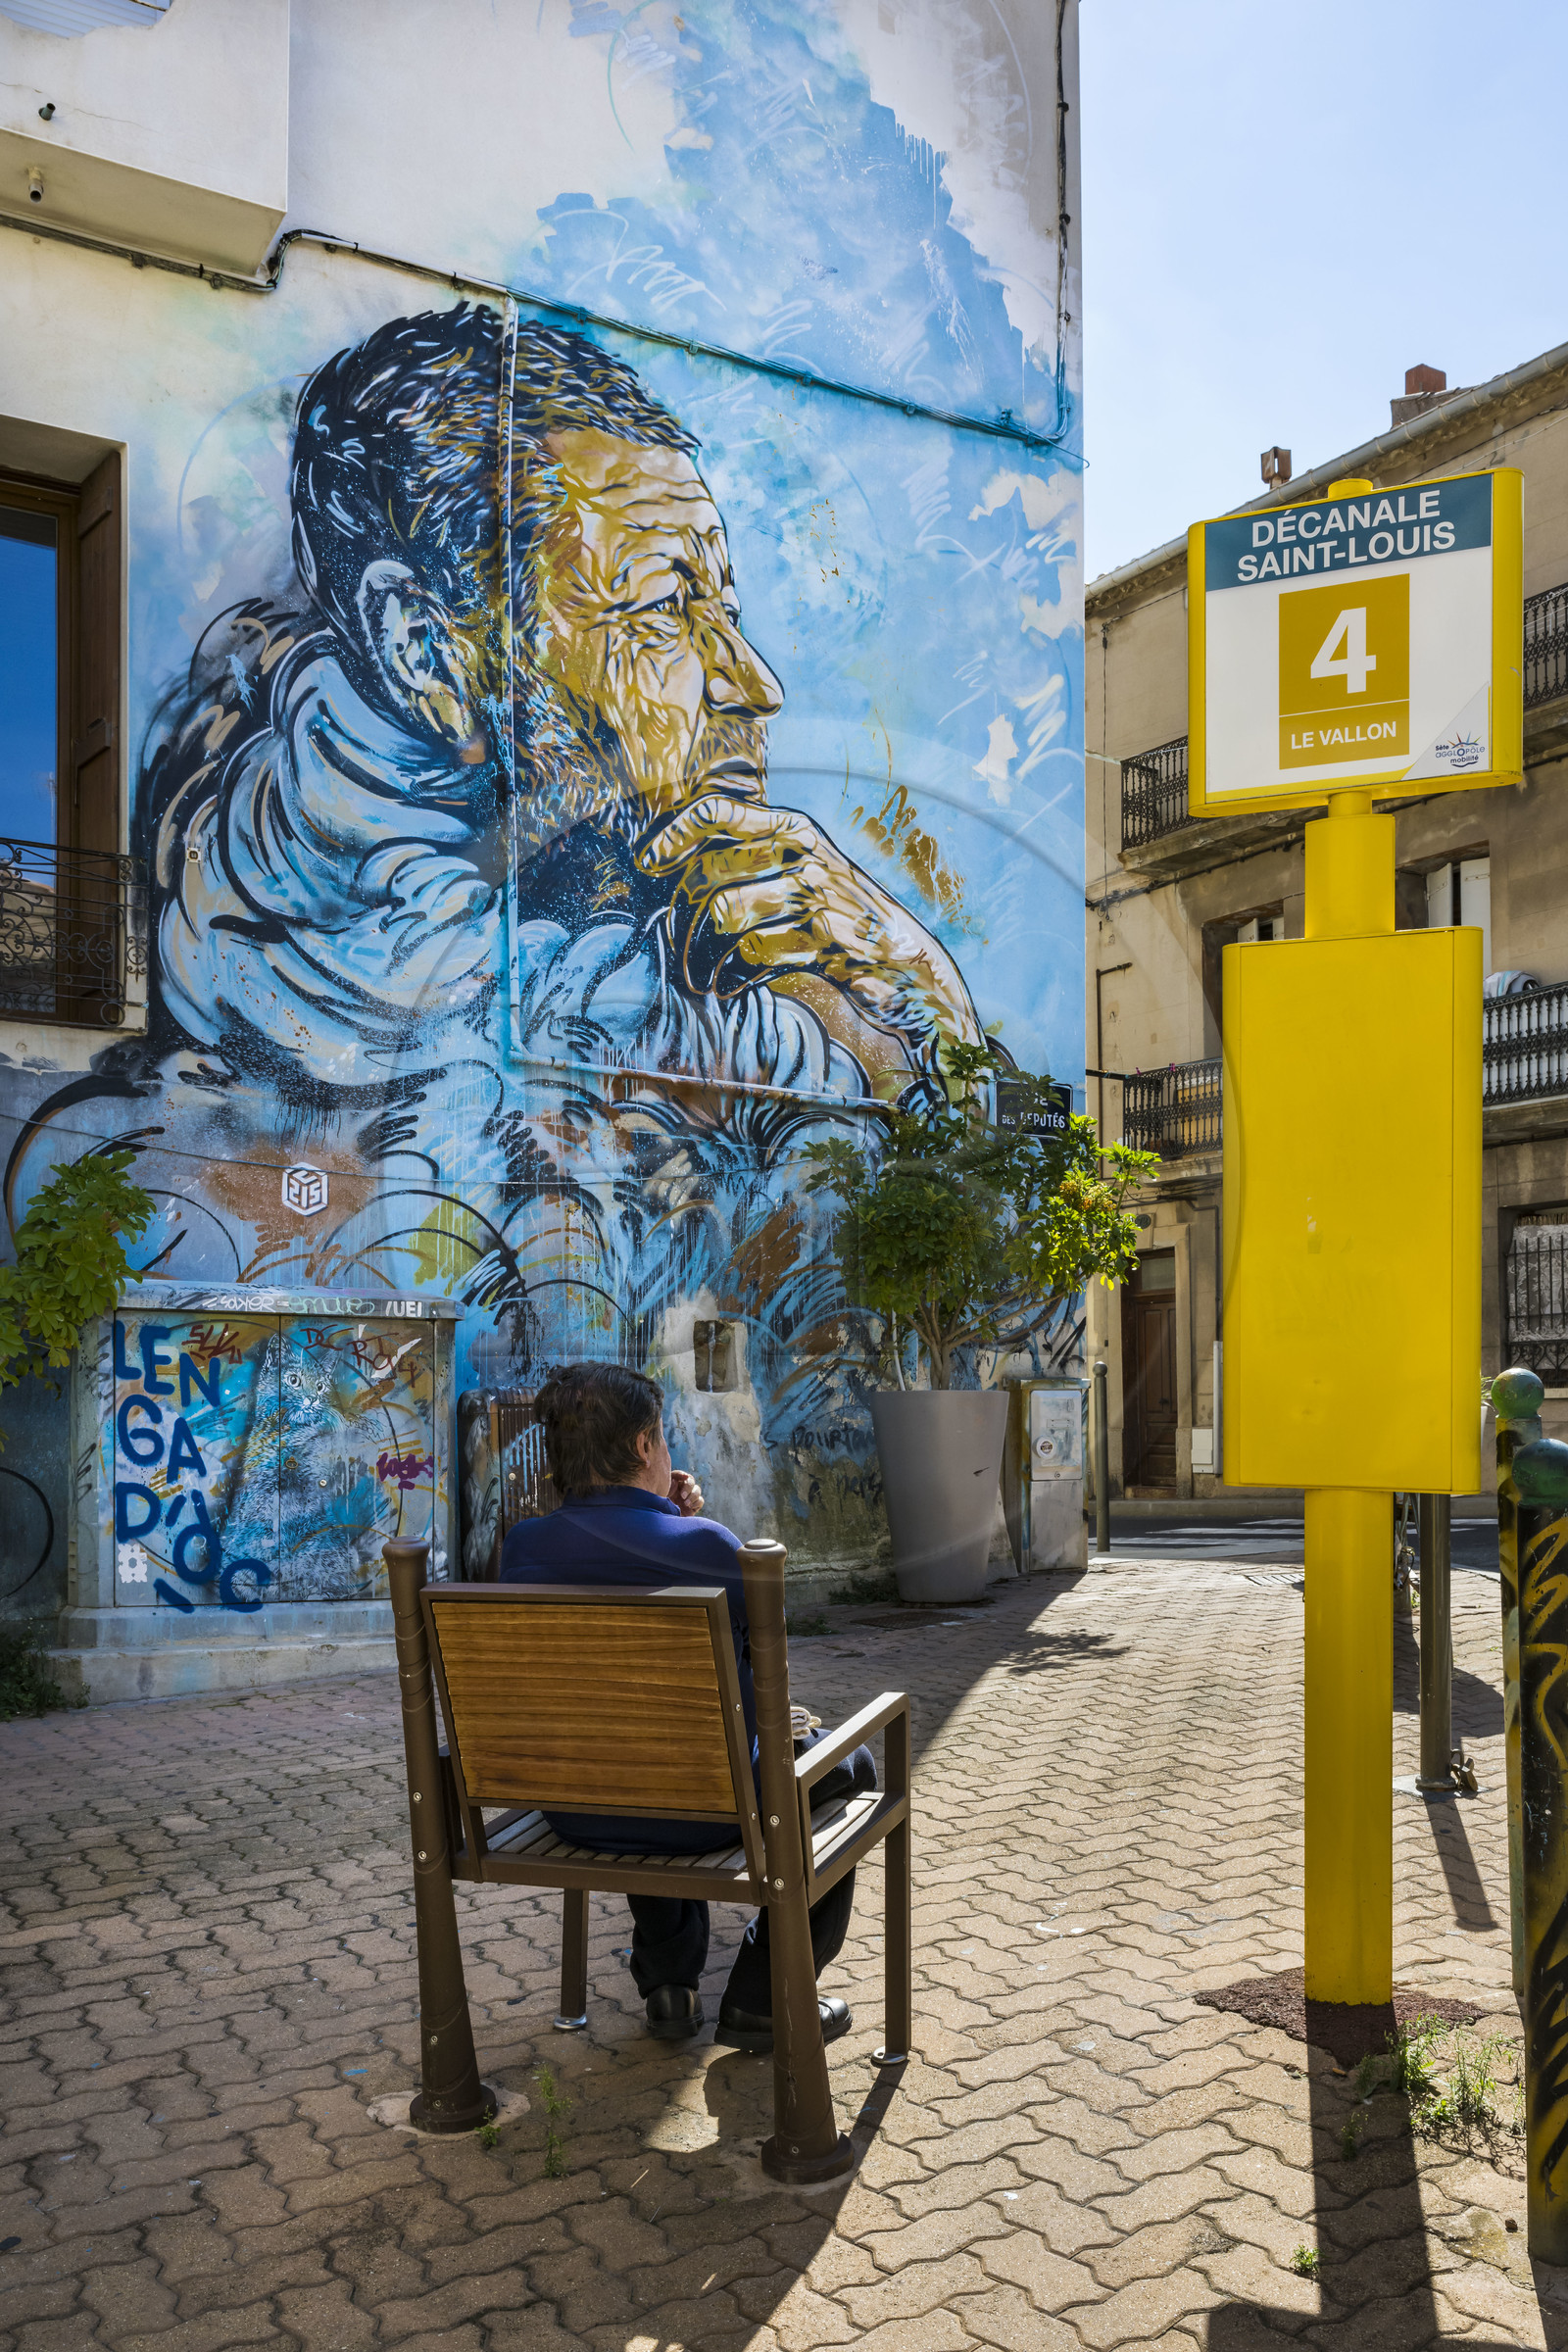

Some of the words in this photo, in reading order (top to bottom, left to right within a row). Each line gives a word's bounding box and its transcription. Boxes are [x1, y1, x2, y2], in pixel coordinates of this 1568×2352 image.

[1252, 490, 1441, 548] DÉCANALE
[1237, 521, 1456, 581] SAINT-LOUIS
[1310, 607, 1377, 694] 4
[1291, 731, 1314, 750] LE
[1318, 721, 1397, 746] VALLON
[1450, 755, 1479, 763] mobilité
[113, 1320, 221, 1407] LEN
